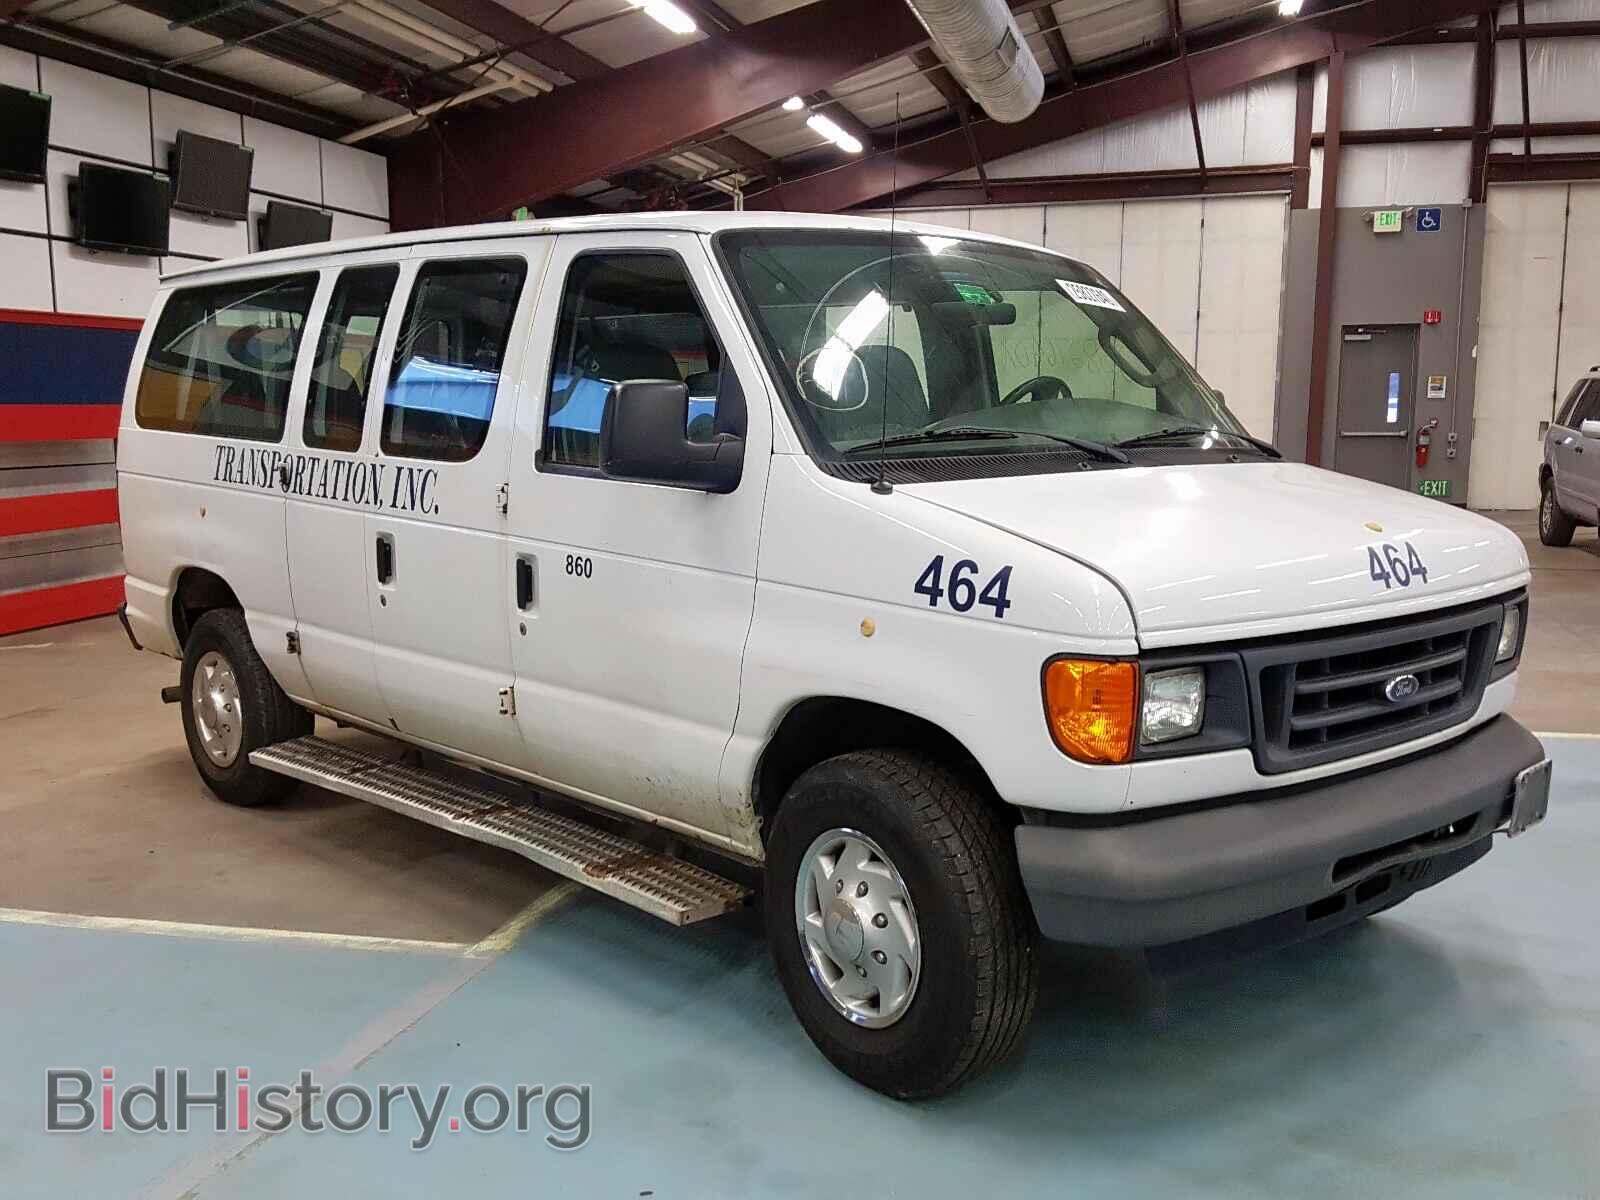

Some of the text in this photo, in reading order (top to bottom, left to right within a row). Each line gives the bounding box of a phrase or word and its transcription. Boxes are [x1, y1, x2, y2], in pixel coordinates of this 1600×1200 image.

[213, 445, 440, 515] TRANSPORTATION, INC.
[1423, 480, 1448, 496] EXIT
[566, 554, 593, 579] 860
[913, 554, 1014, 619] 464
[1367, 541, 1428, 589] 464
